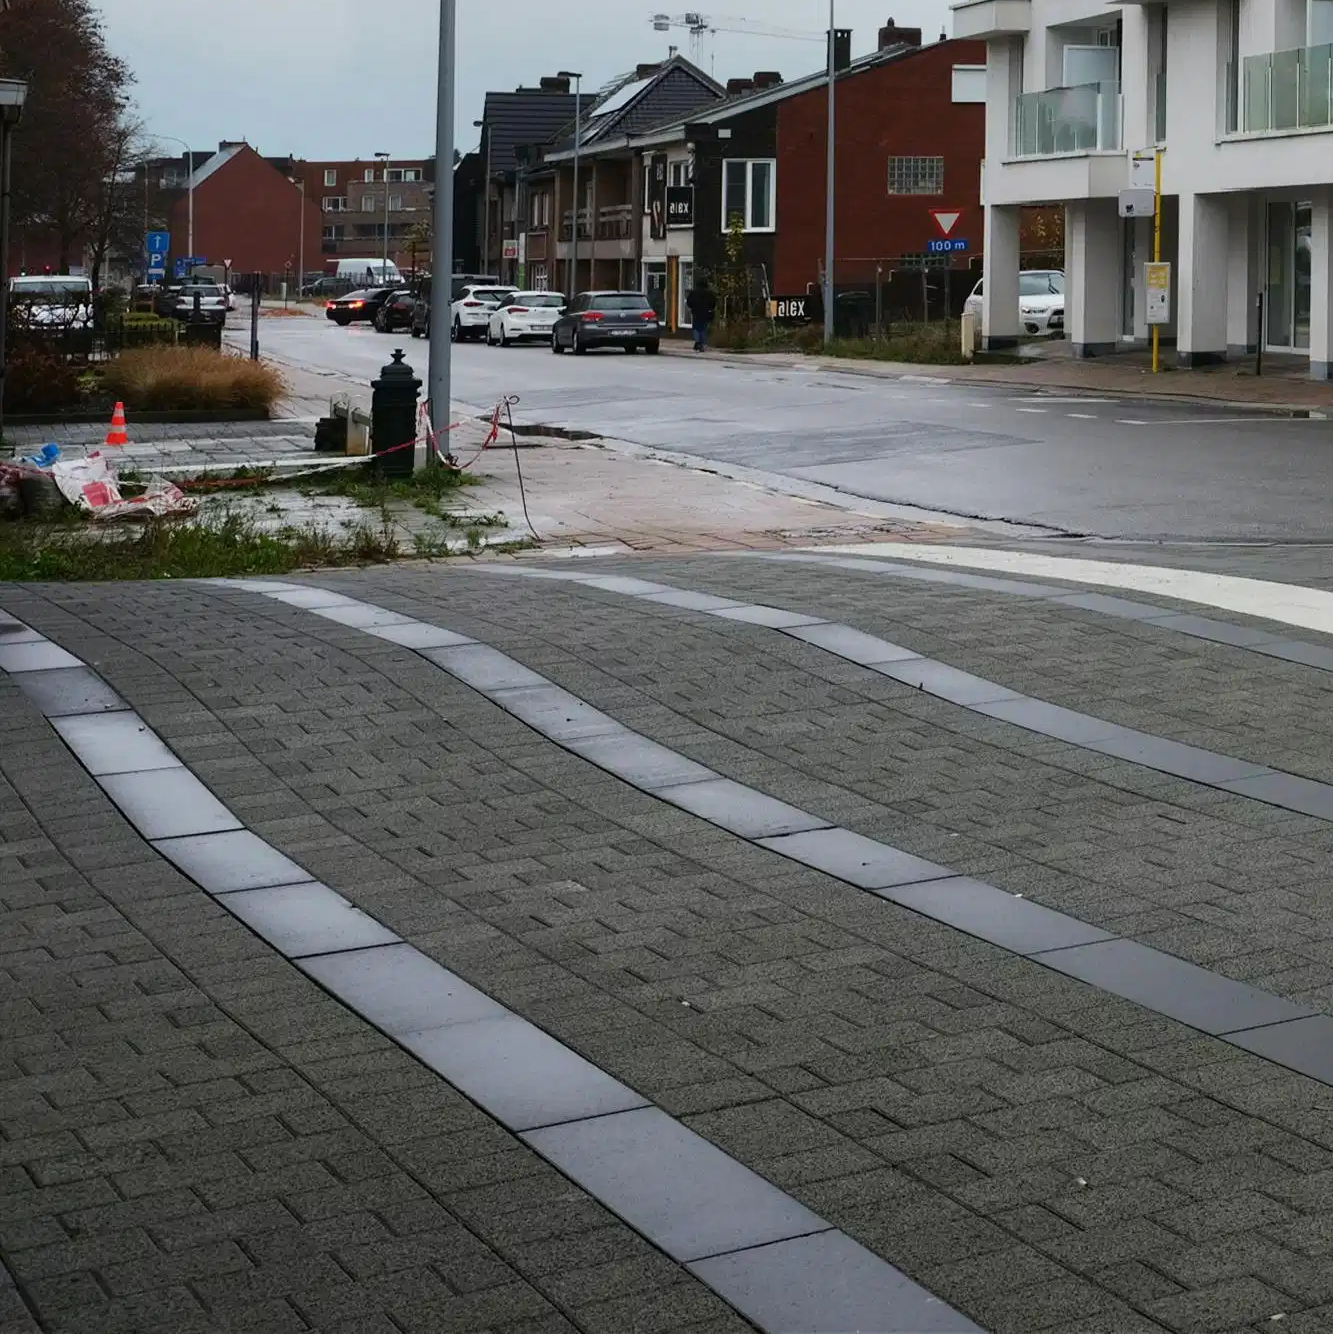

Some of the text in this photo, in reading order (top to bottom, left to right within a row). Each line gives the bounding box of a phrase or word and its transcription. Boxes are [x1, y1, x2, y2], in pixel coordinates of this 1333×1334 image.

[669, 202, 689, 214] alex
[931, 241, 965, 251] 100 m
[151, 253, 161, 266] P
[778, 300, 805, 317] alex
